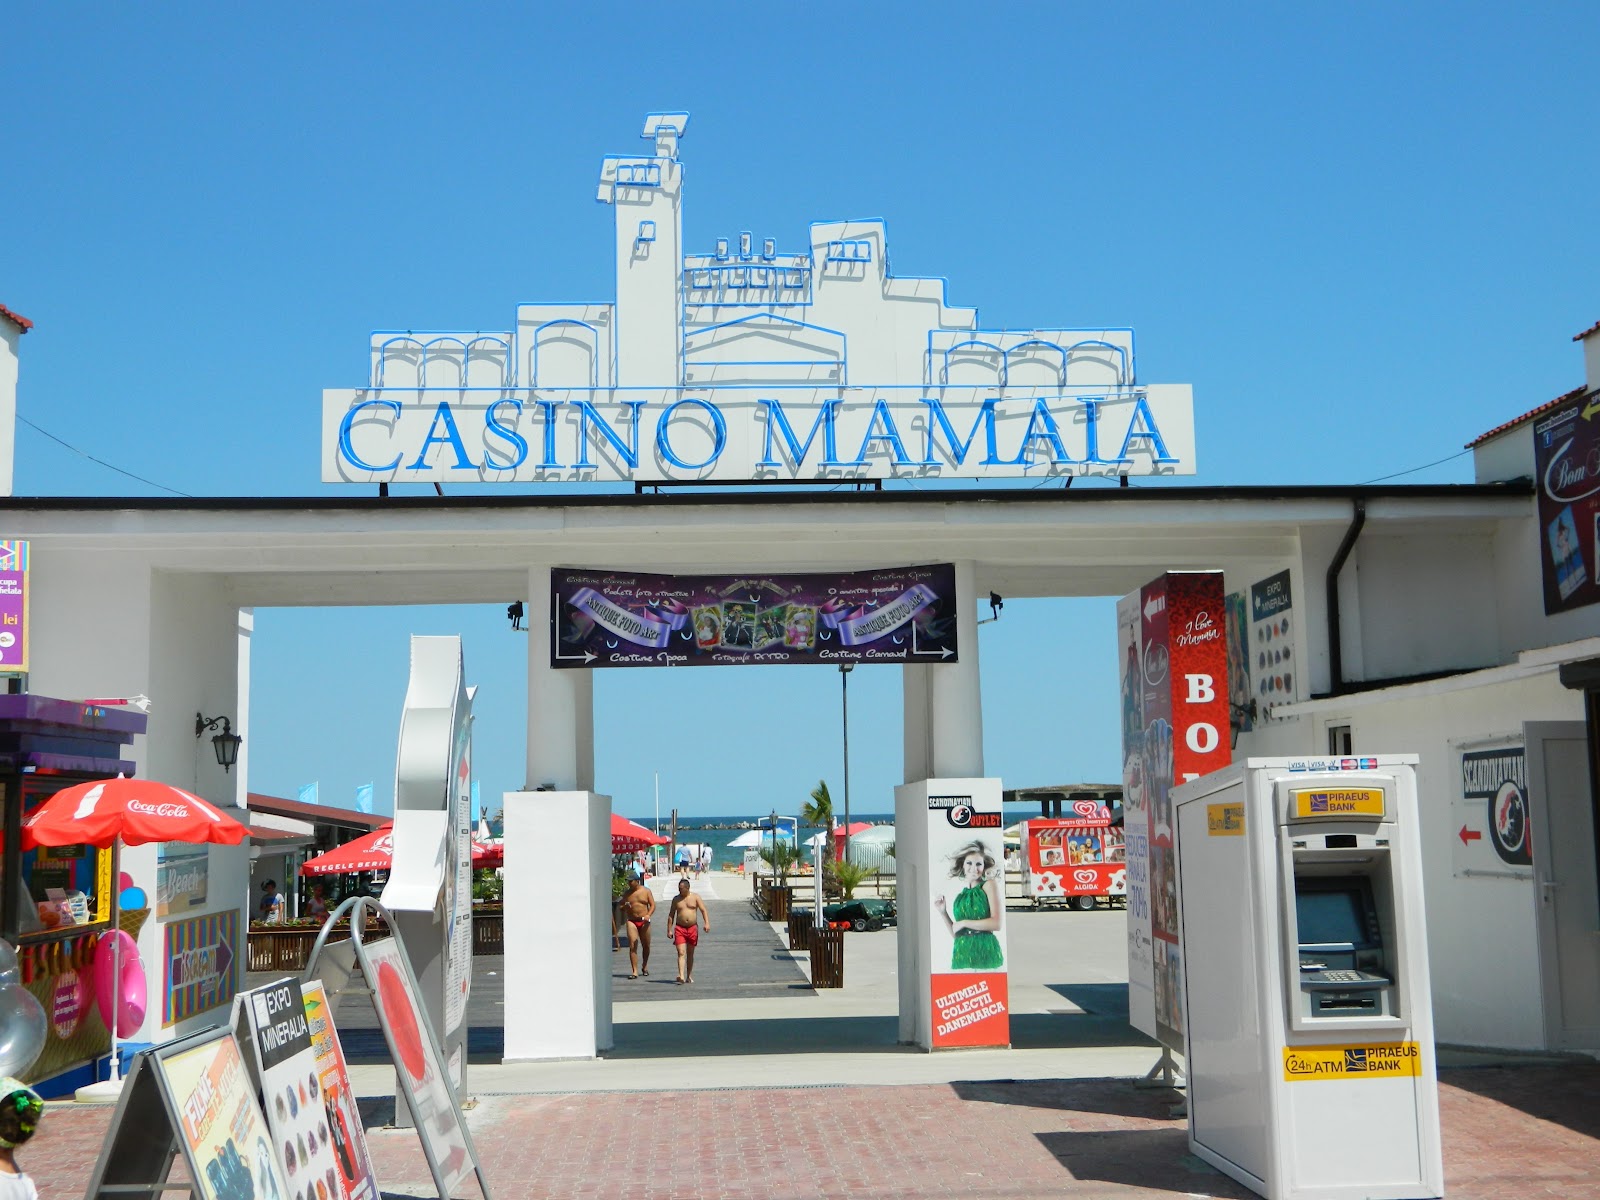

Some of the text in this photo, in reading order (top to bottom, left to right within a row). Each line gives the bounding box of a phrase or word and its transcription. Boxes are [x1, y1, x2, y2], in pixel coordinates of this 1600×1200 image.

[338, 396, 1181, 471] CASINO MAMAIA
[1552, 457, 1586, 492] Bom
[1266, 581, 1282, 596] EXPO
[3, 612, 18, 625] lei
[585, 596, 661, 641] ANTIQUE FOTO ART
[851, 591, 926, 637] ANTIQUE FOTO ART
[1195, 611, 1213, 630] love
[1176, 629, 1220, 646] Mamaia
[609, 652, 654, 662] Costume
[818, 649, 862, 660] Costume
[1463, 755, 1524, 793] SCANDINAVIAN
[928, 797, 971, 808] SCANDINAVIAN
[1329, 792, 1370, 801] PIRAEUS
[127, 799, 190, 817] Coca-Cola
[1329, 802, 1356, 811] BANK
[970, 814, 1000, 826] OUTLET
[314, 860, 388, 873] REGELE BERII
[168, 866, 199, 903] Beach
[266, 986, 292, 1015] EXPO
[935, 980, 989, 1009] ULTIMELE
[936, 1001, 1006, 1036] DANEMARCA
[261, 1014, 308, 1053] MINERALIA
[1367, 1046, 1418, 1058] PIRAEUS
[1290, 1060, 1343, 1073] 24h ATM
[1368, 1059, 1401, 1071] BANK
[184, 1065, 215, 1142] FILME
